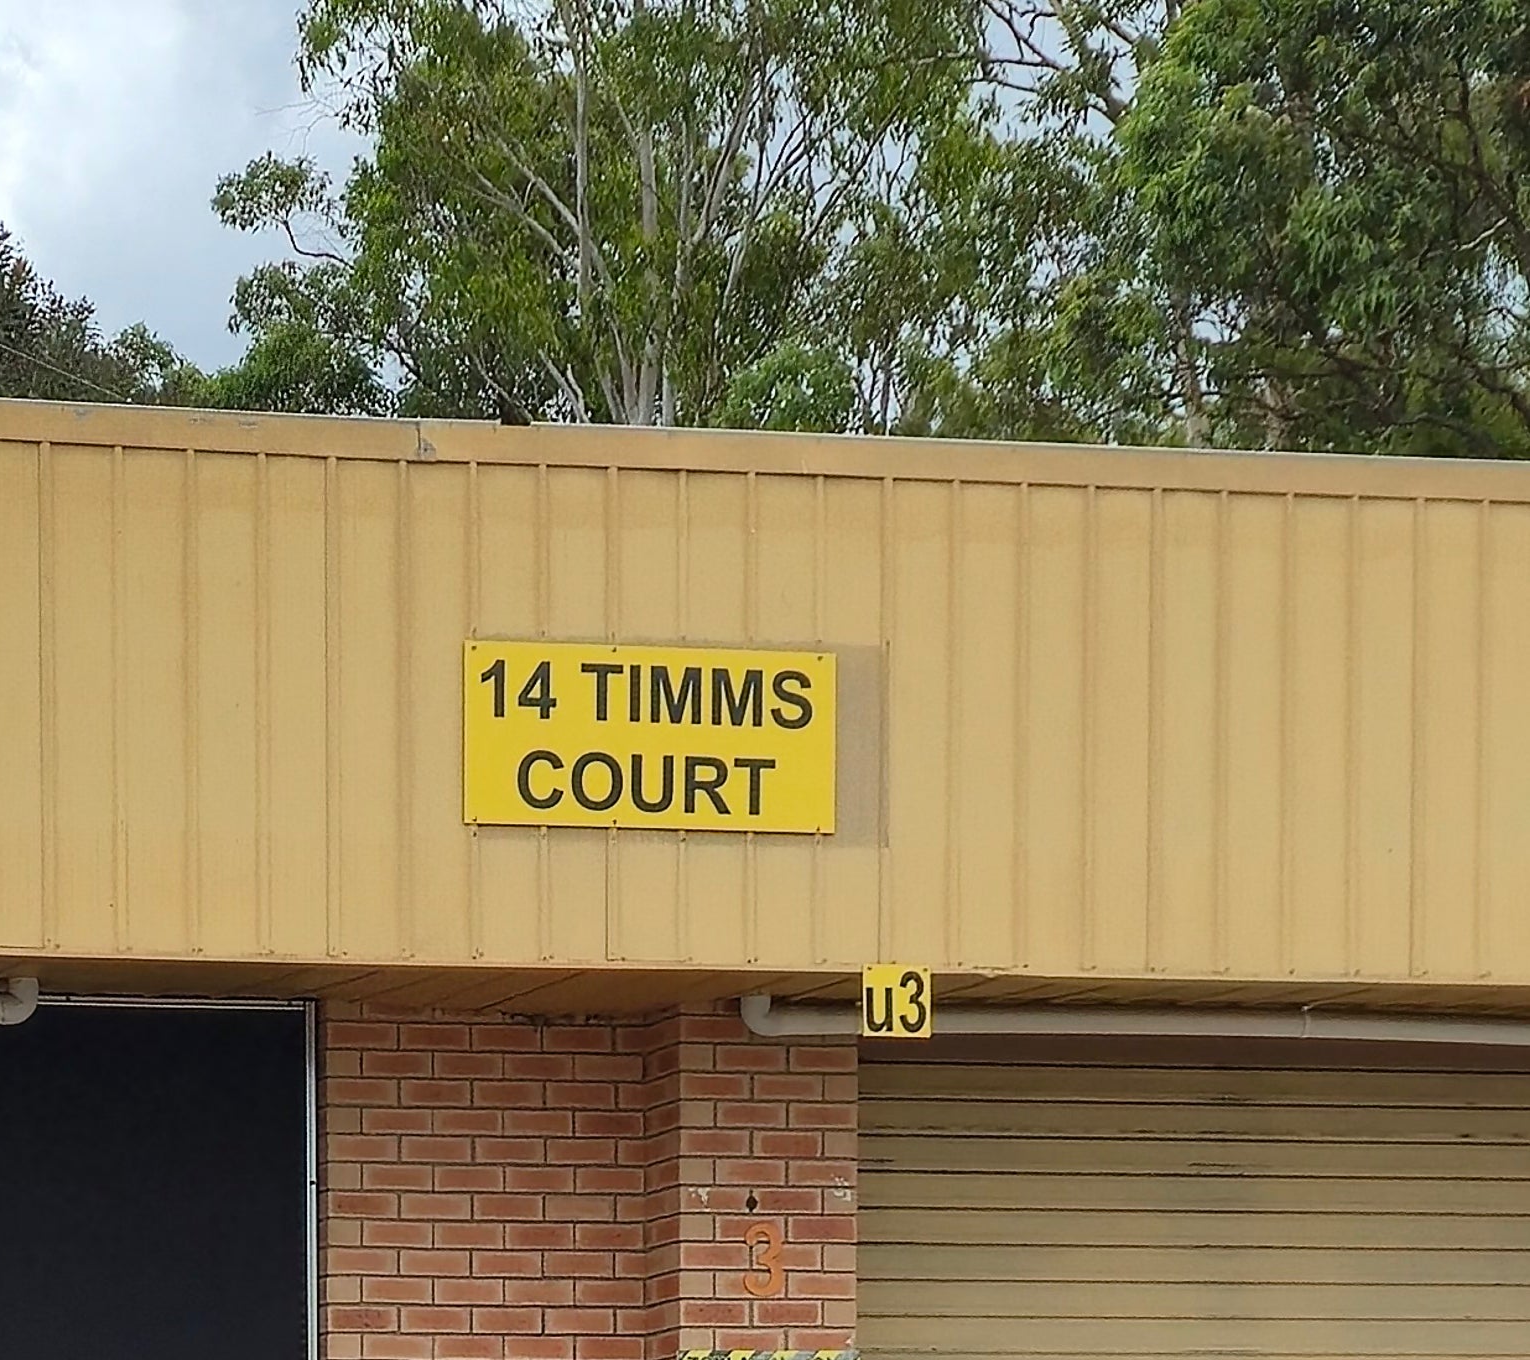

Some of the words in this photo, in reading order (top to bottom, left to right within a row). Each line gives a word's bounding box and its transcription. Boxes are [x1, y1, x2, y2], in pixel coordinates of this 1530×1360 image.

[480, 658, 557, 720] 14
[581, 662, 814, 730] TIMMS
[517, 749, 777, 816] COURT
[865, 970, 928, 1033] u3
[742, 1221, 786, 1298] 3
